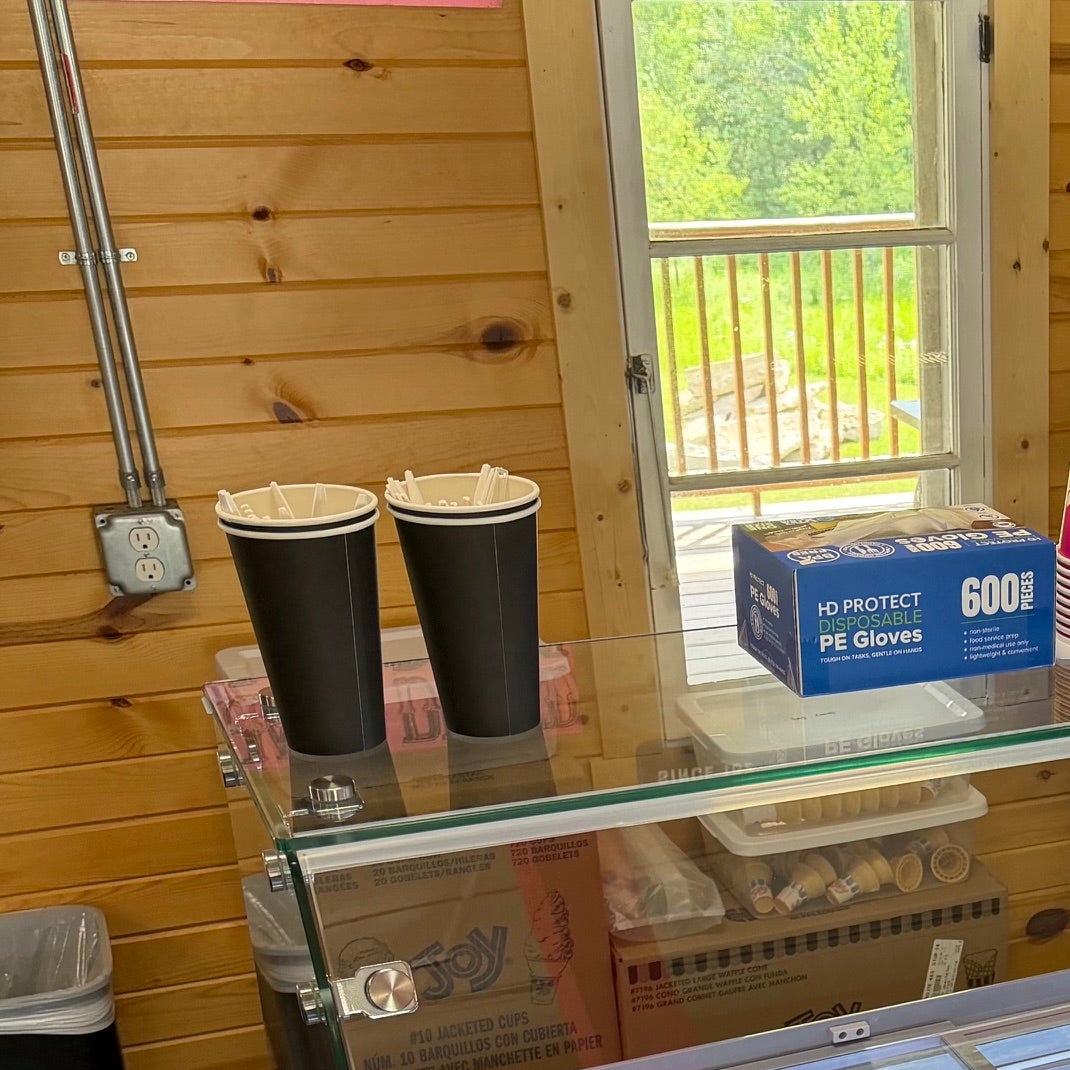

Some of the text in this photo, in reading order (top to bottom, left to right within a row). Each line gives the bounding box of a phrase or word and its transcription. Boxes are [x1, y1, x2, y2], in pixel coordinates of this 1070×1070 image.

[895, 528, 1032, 546] PE Gloves
[818, 592, 922, 617] HD PROTECT
[961, 570, 1034, 618] 600 PIECES
[819, 609, 922, 634] DISPOSABLE
[819, 628, 923, 653] PE Gloves
[969, 636, 983, 644] food
[1005, 632, 1019, 640] prep
[1016, 639, 1029, 647] only
[820, 655, 841, 663] TOUGH
[871, 650, 892, 658] GENTLE
[531, 839, 589, 855] BARQUILLOS
[532, 849, 580, 864] GOBELETS
[655, 979, 691, 991] JACKETED
[692, 975, 716, 985] LARGE
[718, 968, 745, 978] WAFFLE
[747, 964, 768, 973] CONE
[656, 990, 680, 1000] CONO
[682, 984, 713, 995] GRANDE
[715, 978, 742, 989] WAFFLE
[744, 974, 762, 983] CON
[763, 969, 788, 980] FUNDA
[656, 997, 685, 1008] GRAND
[686, 992, 716, 1003] CORNET
[749, 980, 767, 991] AVEC
[768, 973, 808, 988] MANCHON
[410, 1011, 529, 1045] #10 JACKETED CUPS
[401, 1050, 415, 1066] 10
[419, 1035, 491, 1062] BARQUILLOS
[495, 1030, 519, 1048] CON
[523, 1021, 578, 1043] CUBIERTA
[546, 1043, 561, 1056] EN
[564, 1035, 603, 1053] PAPIER
